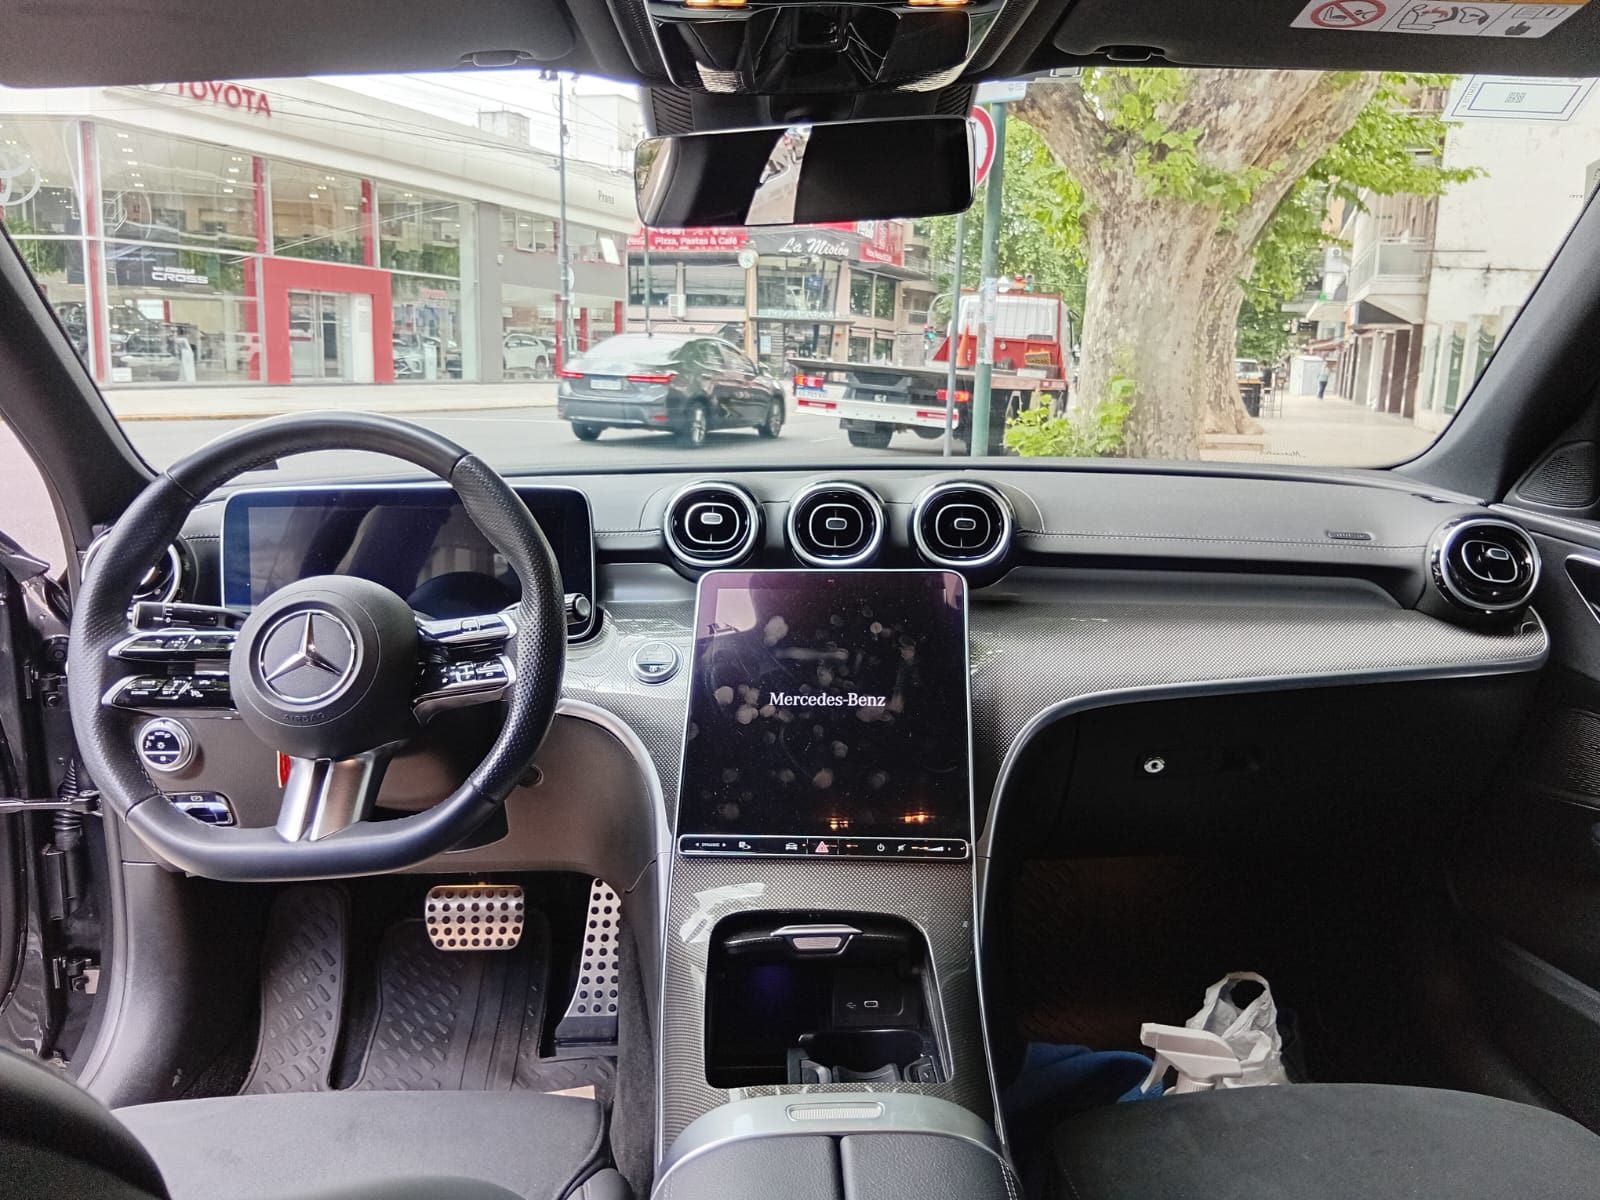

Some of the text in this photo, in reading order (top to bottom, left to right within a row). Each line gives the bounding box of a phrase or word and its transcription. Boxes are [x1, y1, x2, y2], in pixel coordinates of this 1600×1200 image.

[680, 236, 708, 246] Pastas
[778, 237, 802, 253] La
[151, 271, 208, 285] CROSS
[769, 691, 886, 707] Mercedes-Benz
